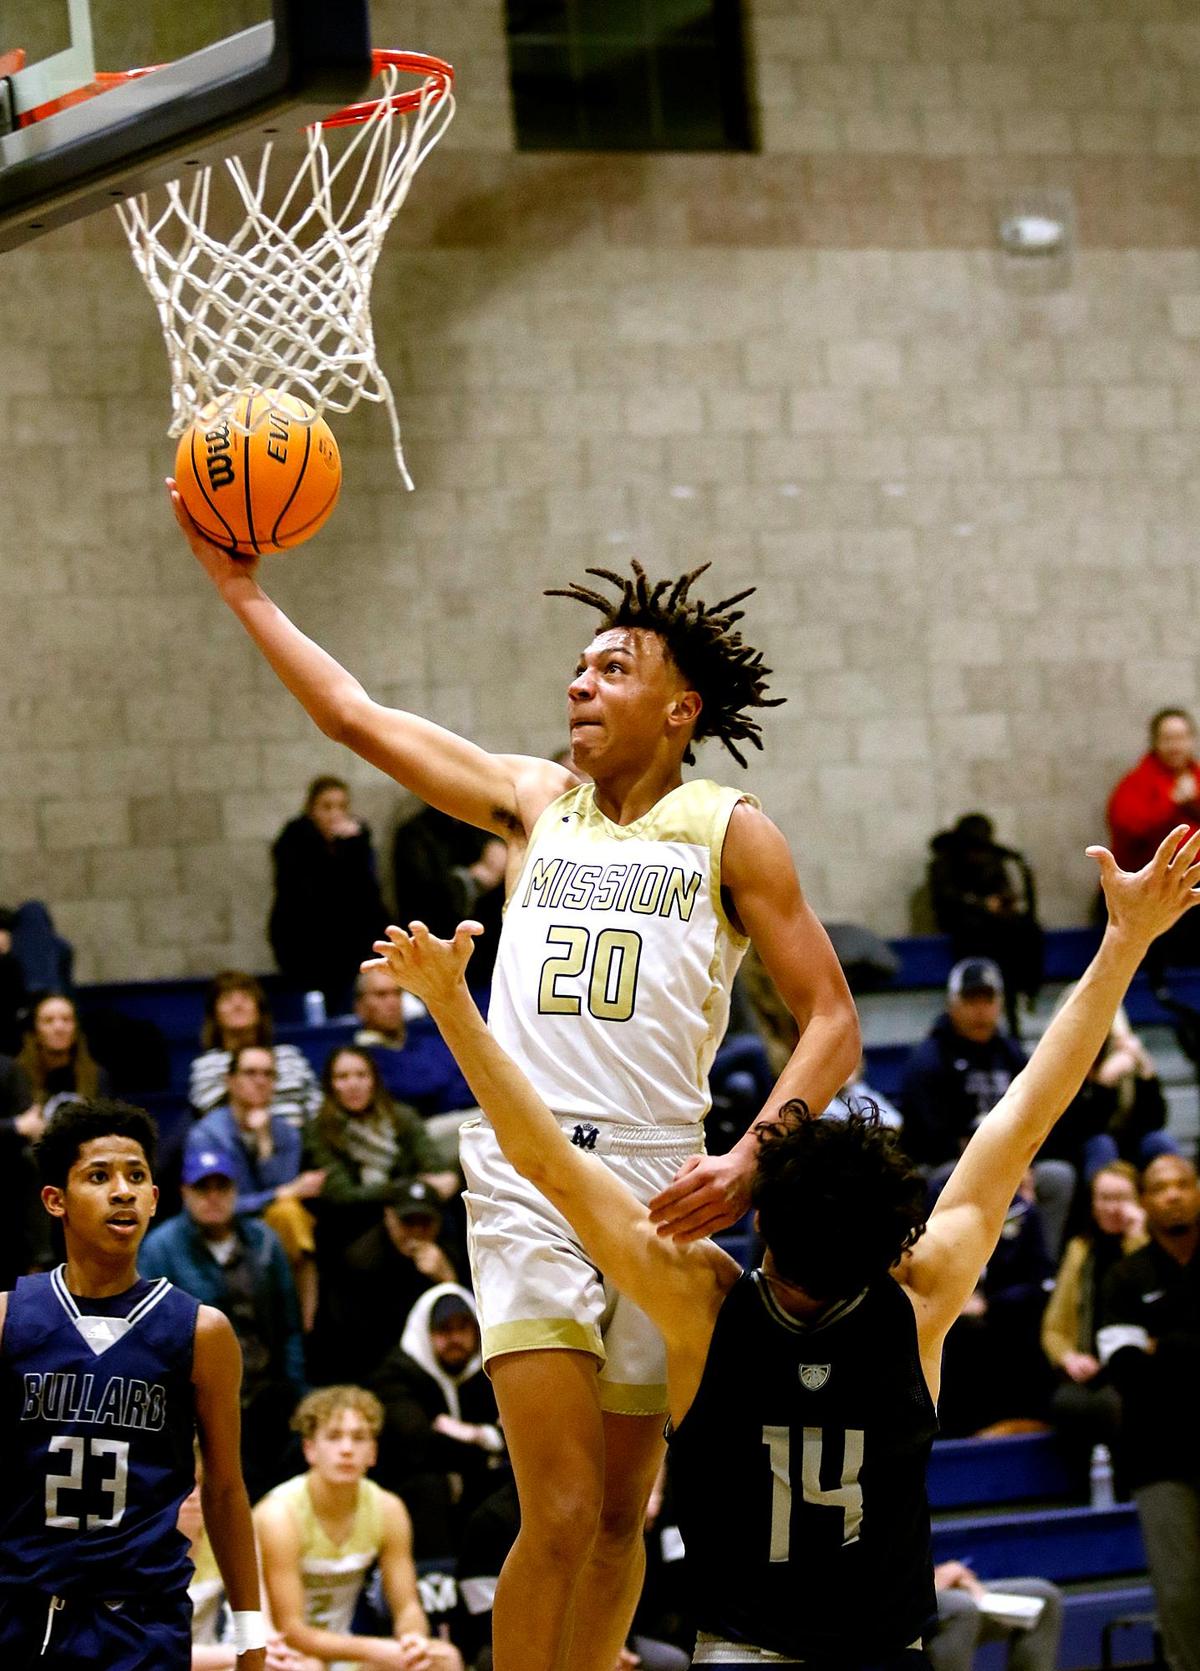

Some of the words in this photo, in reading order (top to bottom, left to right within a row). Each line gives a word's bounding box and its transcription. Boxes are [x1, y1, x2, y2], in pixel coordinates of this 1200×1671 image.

[522, 858, 702, 922] MISSION
[538, 925, 642, 1022] 20
[21, 1373, 166, 1431] BULLARD
[45, 1436, 130, 1530] 23
[762, 1425, 865, 1562] 14
